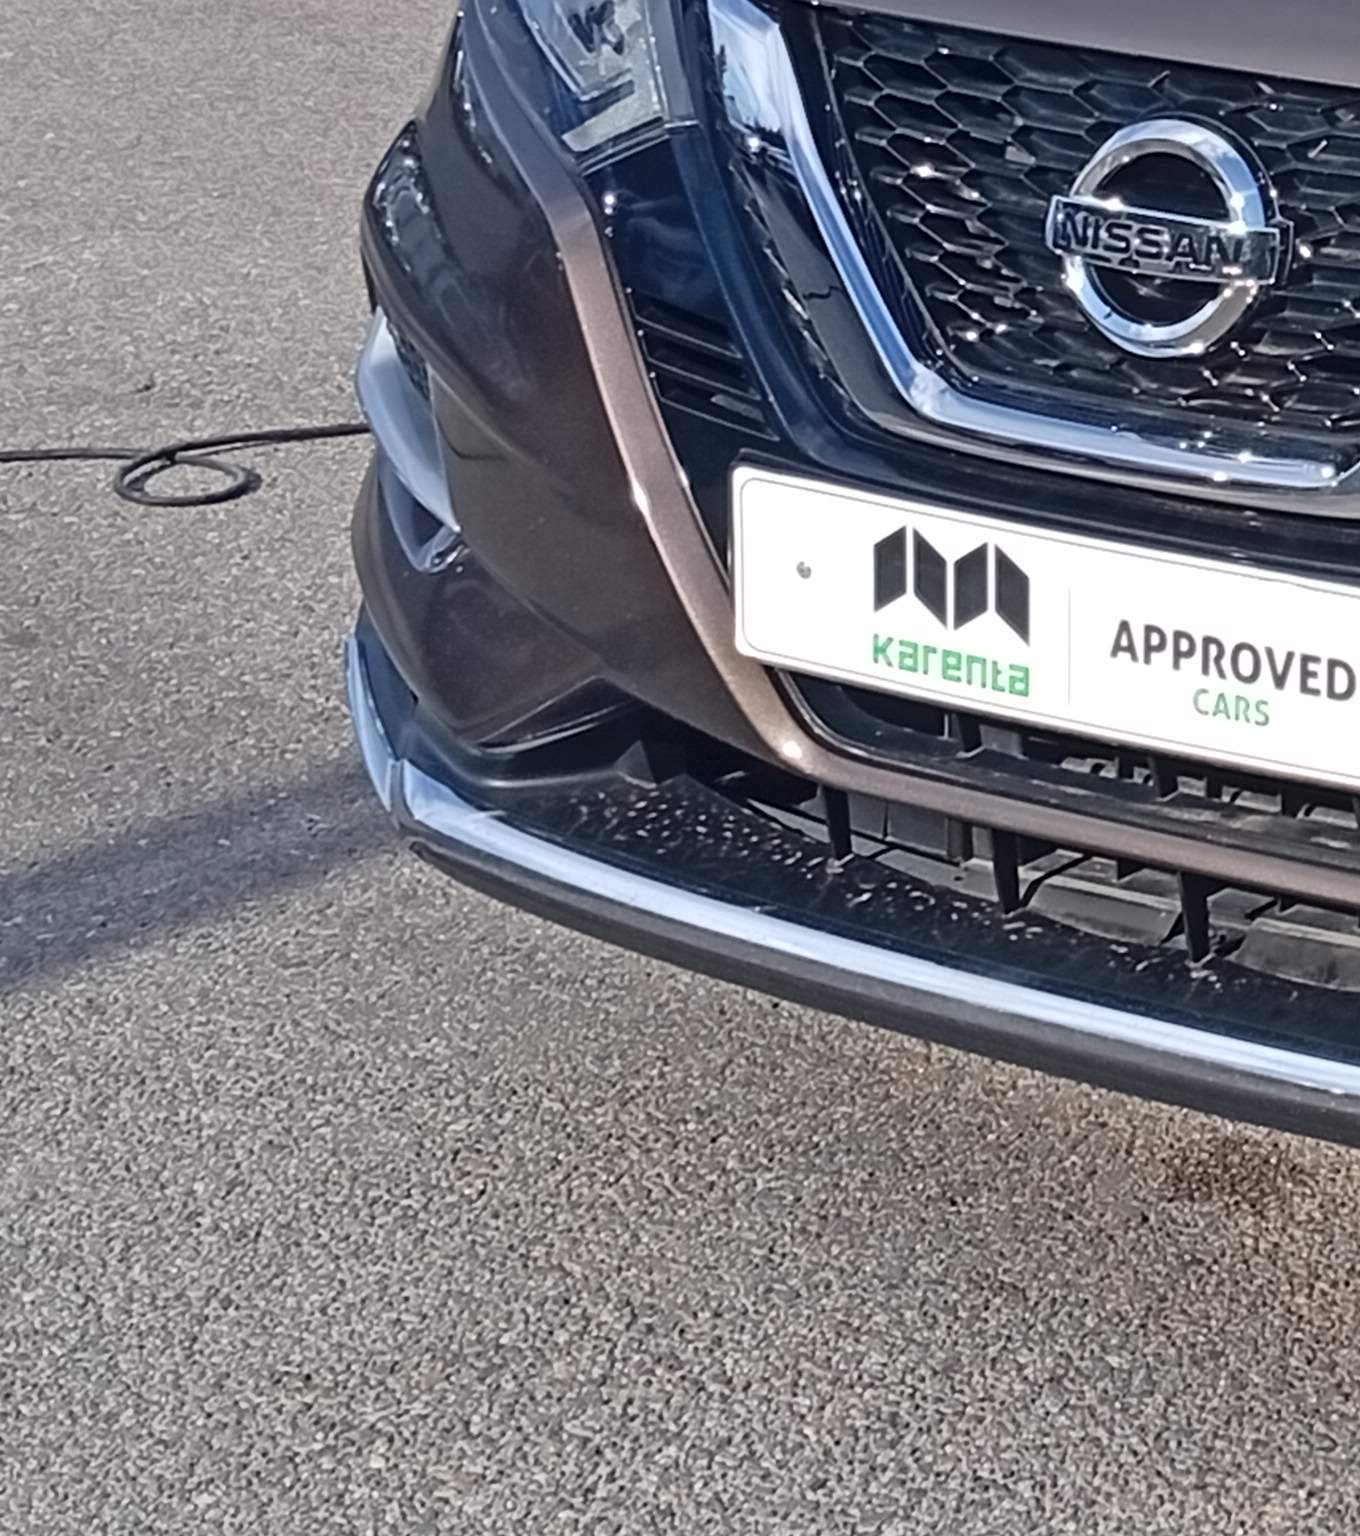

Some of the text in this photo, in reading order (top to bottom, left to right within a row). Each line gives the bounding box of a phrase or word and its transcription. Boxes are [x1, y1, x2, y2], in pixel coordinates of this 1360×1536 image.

[1055, 204, 1243, 268] NISSAN
[1110, 619, 1357, 702] APPROVED
[1193, 688, 1270, 727] CARS
